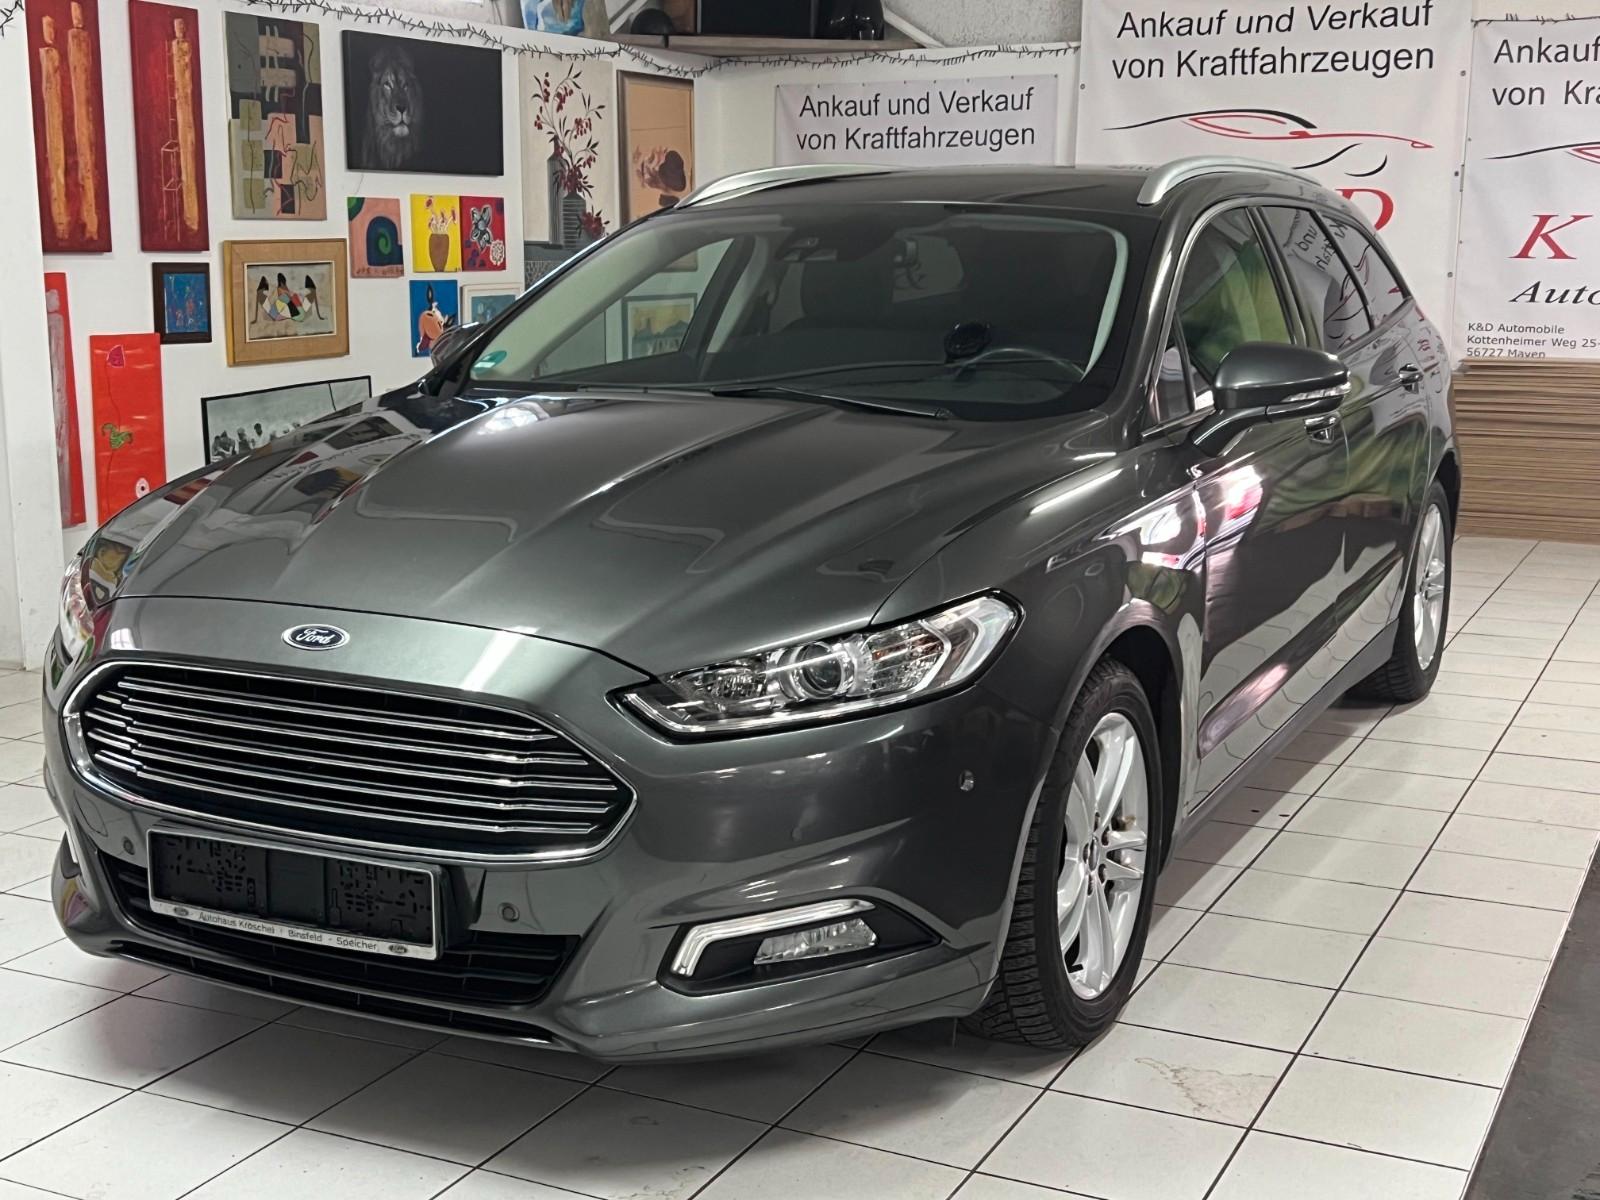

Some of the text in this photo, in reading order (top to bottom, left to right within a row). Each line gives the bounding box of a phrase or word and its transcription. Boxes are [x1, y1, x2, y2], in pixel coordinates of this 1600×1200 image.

[1117, 0, 1433, 38] Ankauf und Verkauf
[1112, 46, 1434, 79] von Kraftfahrzeugen
[799, 87, 1035, 118] Ankauf und Verkauf
[1492, 86, 1545, 106] von
[797, 125, 1035, 152] von Kraftfahrzeugen
[1508, 214, 1593, 260] K
[1466, 335, 1547, 346] Kottenheimer
[1551, 337, 1577, 349] Weg
[1468, 322, 1565, 335] K&D Automobile
[1466, 347, 1504, 357] 56727
[295, 628, 336, 644] Ford
[198, 912, 237, 927] Autohaus
[288, 929, 323, 942] Binsfeld
[336, 936, 377, 950] Speicher
